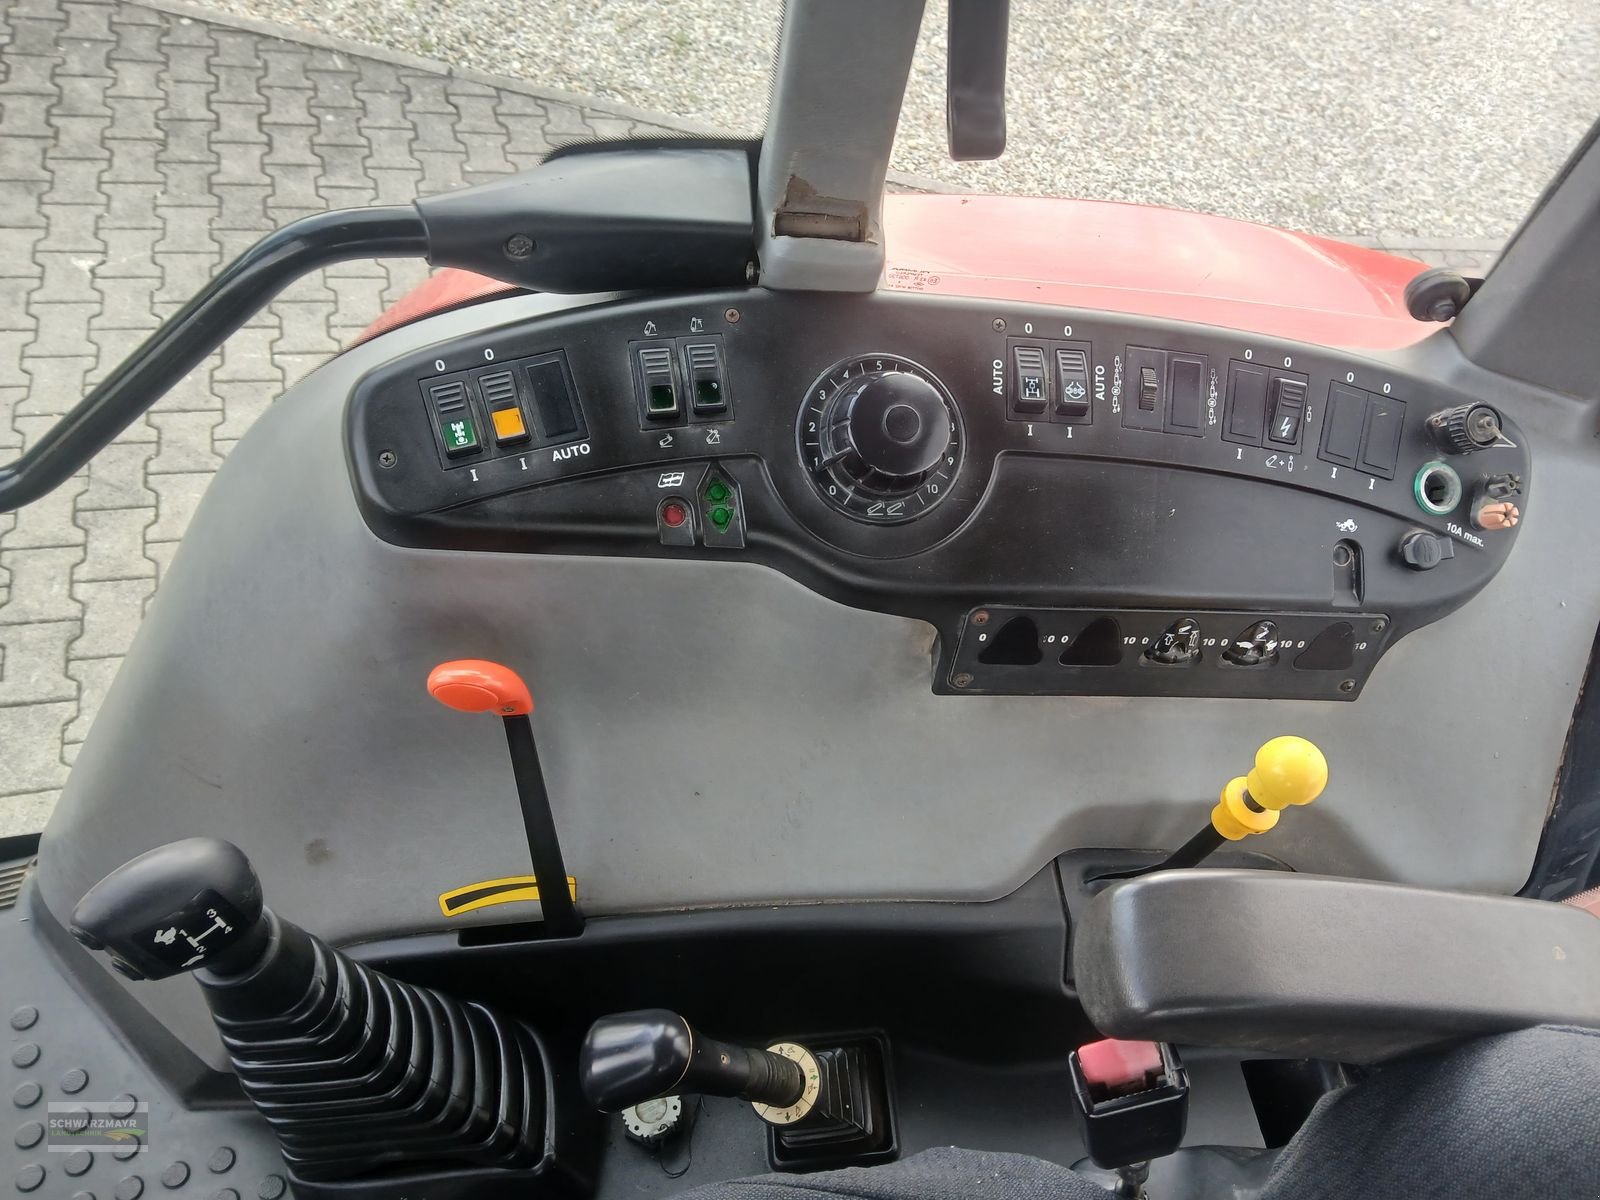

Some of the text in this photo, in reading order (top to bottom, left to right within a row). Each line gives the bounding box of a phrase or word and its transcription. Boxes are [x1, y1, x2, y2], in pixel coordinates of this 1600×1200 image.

[1024, 322, 1033, 334] 0
[1064, 325, 1073, 337] 0
[484, 348, 494, 361] 0
[1244, 349, 1253, 360] 0
[435, 359, 446, 372] 0
[876, 361, 883, 370] 5
[1283, 356, 1292, 368] 0
[842, 370, 849, 379] 4
[992, 359, 1003, 395] AUTO
[1346, 371, 1355, 383] 0
[1095, 365, 1106, 401] AUTO
[1383, 382, 1392, 394] 0
[819, 390, 826, 400] 3
[808, 422, 816, 432] 2
[551, 442, 591, 462] AUTO
[814, 457, 819, 466] 1
[947, 456, 954, 466] 9
[829, 485, 837, 495] 0
[926, 484, 939, 494] 10
[1447, 522, 1484, 547] 10A max.
[978, 633, 987, 642] 0
[1060, 635, 1069, 643] 0
[1123, 636, 1137, 645] 10
[1141, 636, 1150, 645] 0
[1202, 638, 1216, 646] 10
[1220, 638, 1229, 647] 0
[1280, 640, 1293, 648] 10
[1297, 640, 1305, 648] 0
[206, 908, 217, 919] 3
[178, 929, 188, 937] 1
[195, 944, 207, 954] 2
